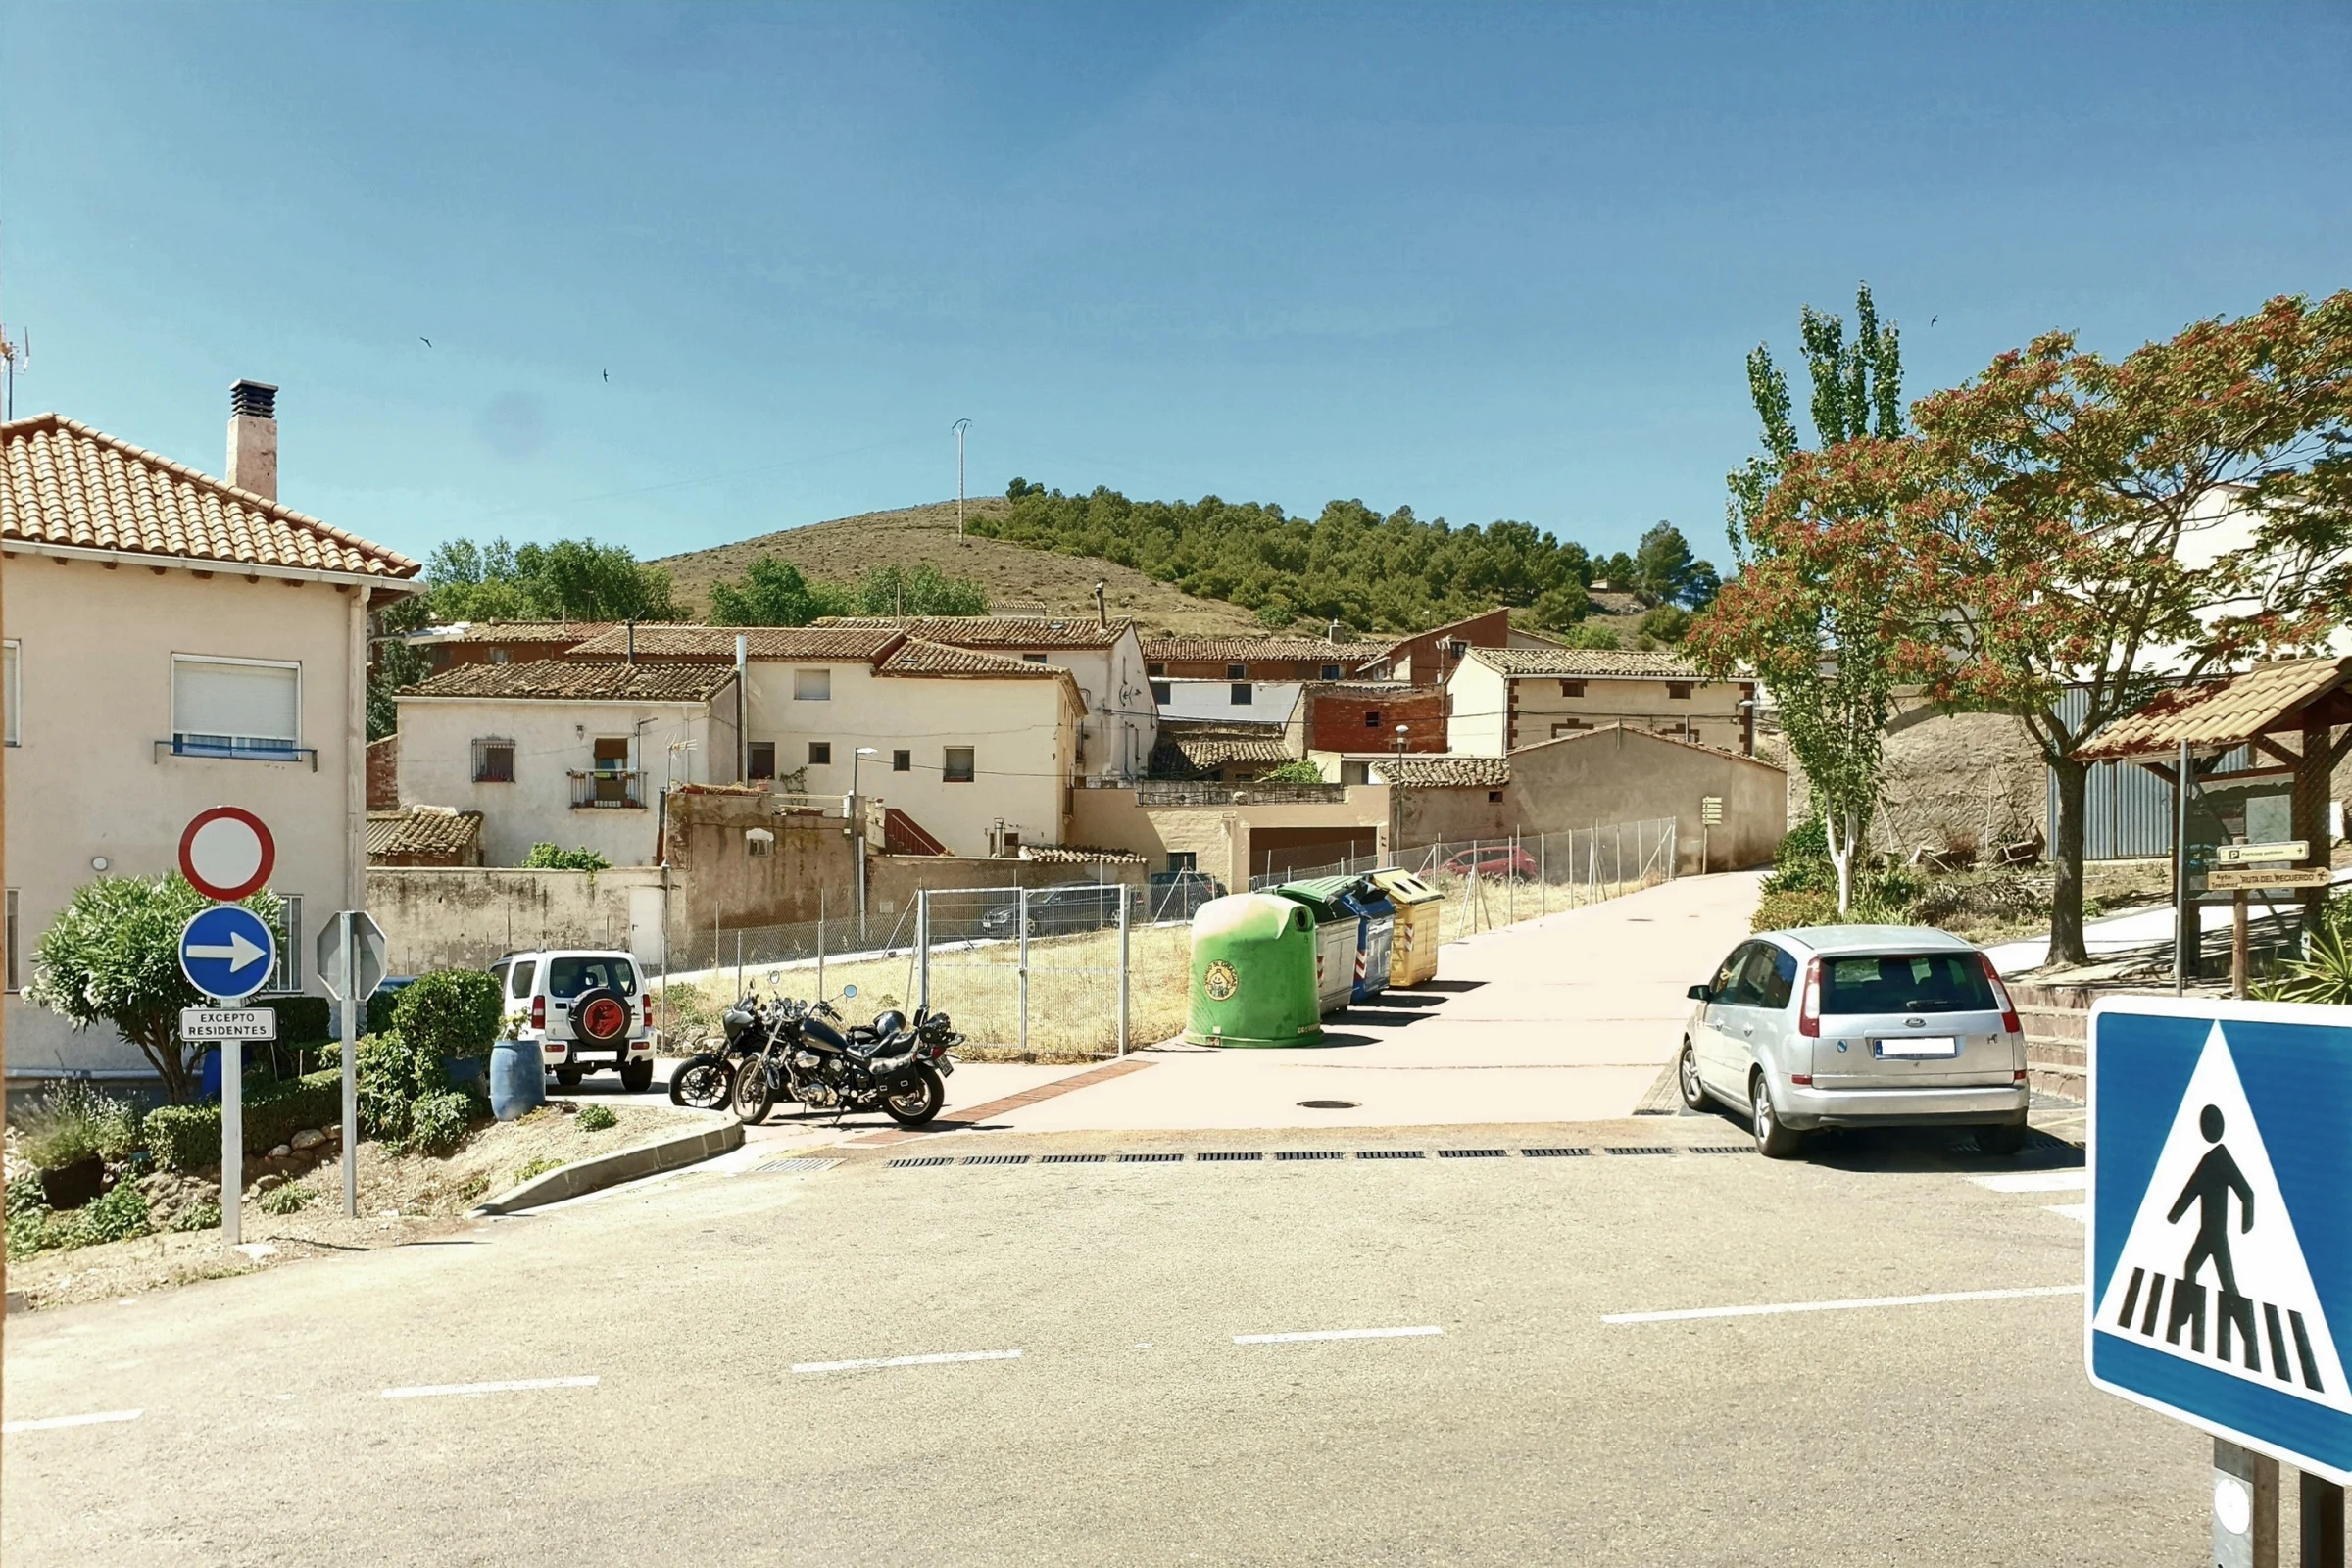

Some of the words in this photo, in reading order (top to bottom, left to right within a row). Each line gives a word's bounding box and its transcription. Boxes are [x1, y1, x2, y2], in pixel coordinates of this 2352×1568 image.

[2239, 874, 2259, 883] RUTA
[200, 1013, 255, 1023] EXCEPTO
[188, 1025, 267, 1035] RESIDENTES
